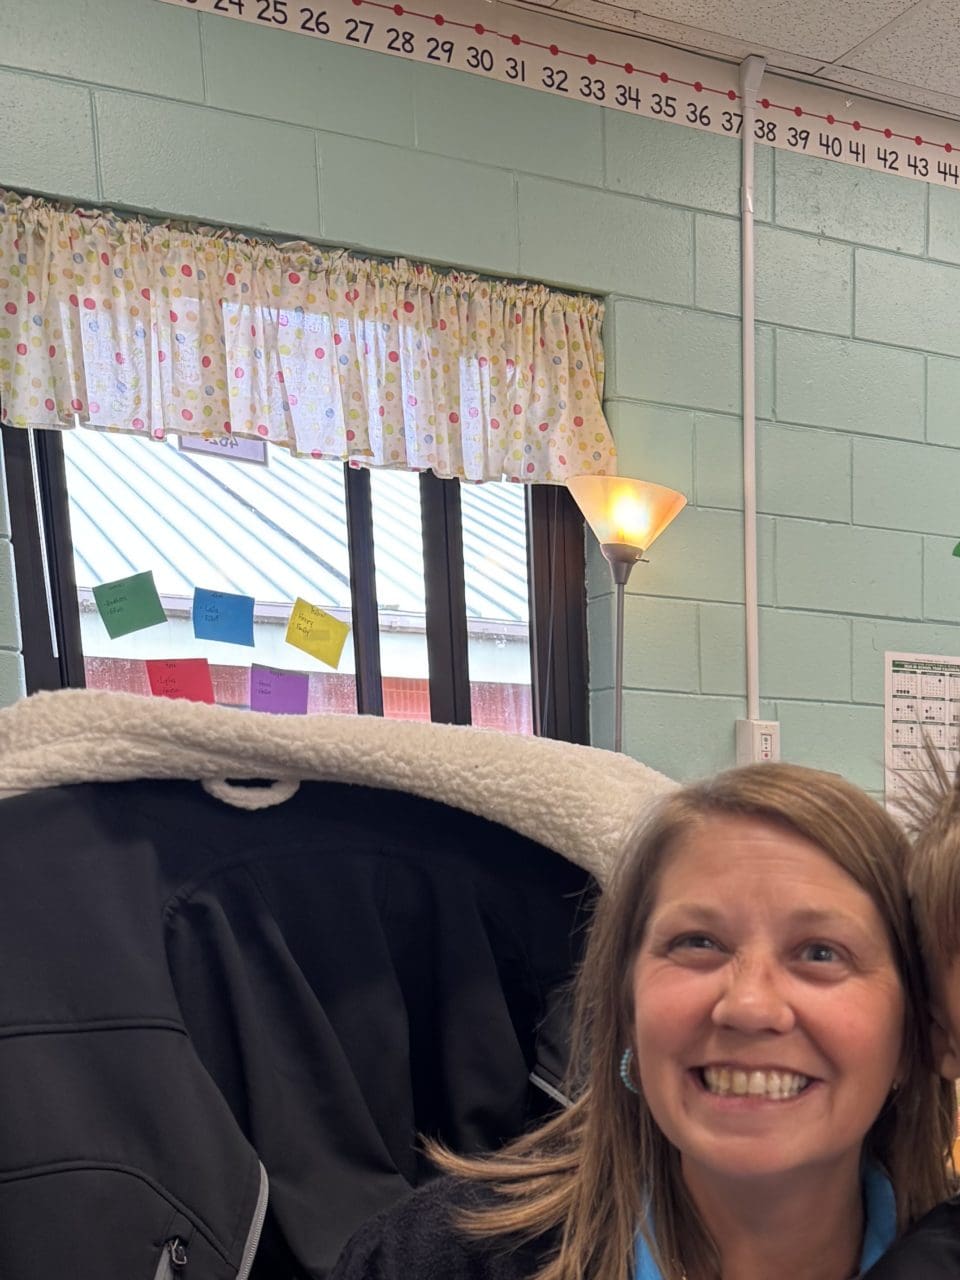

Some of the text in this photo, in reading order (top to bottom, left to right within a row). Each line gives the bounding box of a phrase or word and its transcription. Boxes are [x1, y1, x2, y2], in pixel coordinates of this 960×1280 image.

[256, 0, 288, 25] 25
[300, 8, 330, 34] 26
[345, 18, 374, 44] 27
[386, 28, 415, 53] 28
[426, 37, 455, 63] 29
[466, 46, 494, 72] 30
[505, 57, 525, 82] 31
[541, 66, 569, 92] 32
[579, 76, 606, 101] 33
[614, 84, 641, 110] 34
[650, 93, 677, 118] 35
[685, 102, 711, 127] 36
[721, 111, 744, 134] 37
[754, 119, 777, 141] 38
[787, 126, 810, 150] 39
[819, 133, 842, 157] 40
[849, 140, 866, 164] 41
[877, 146, 899, 171] 42
[907, 154, 929, 177] 43
[937, 160, 959, 184] 44
